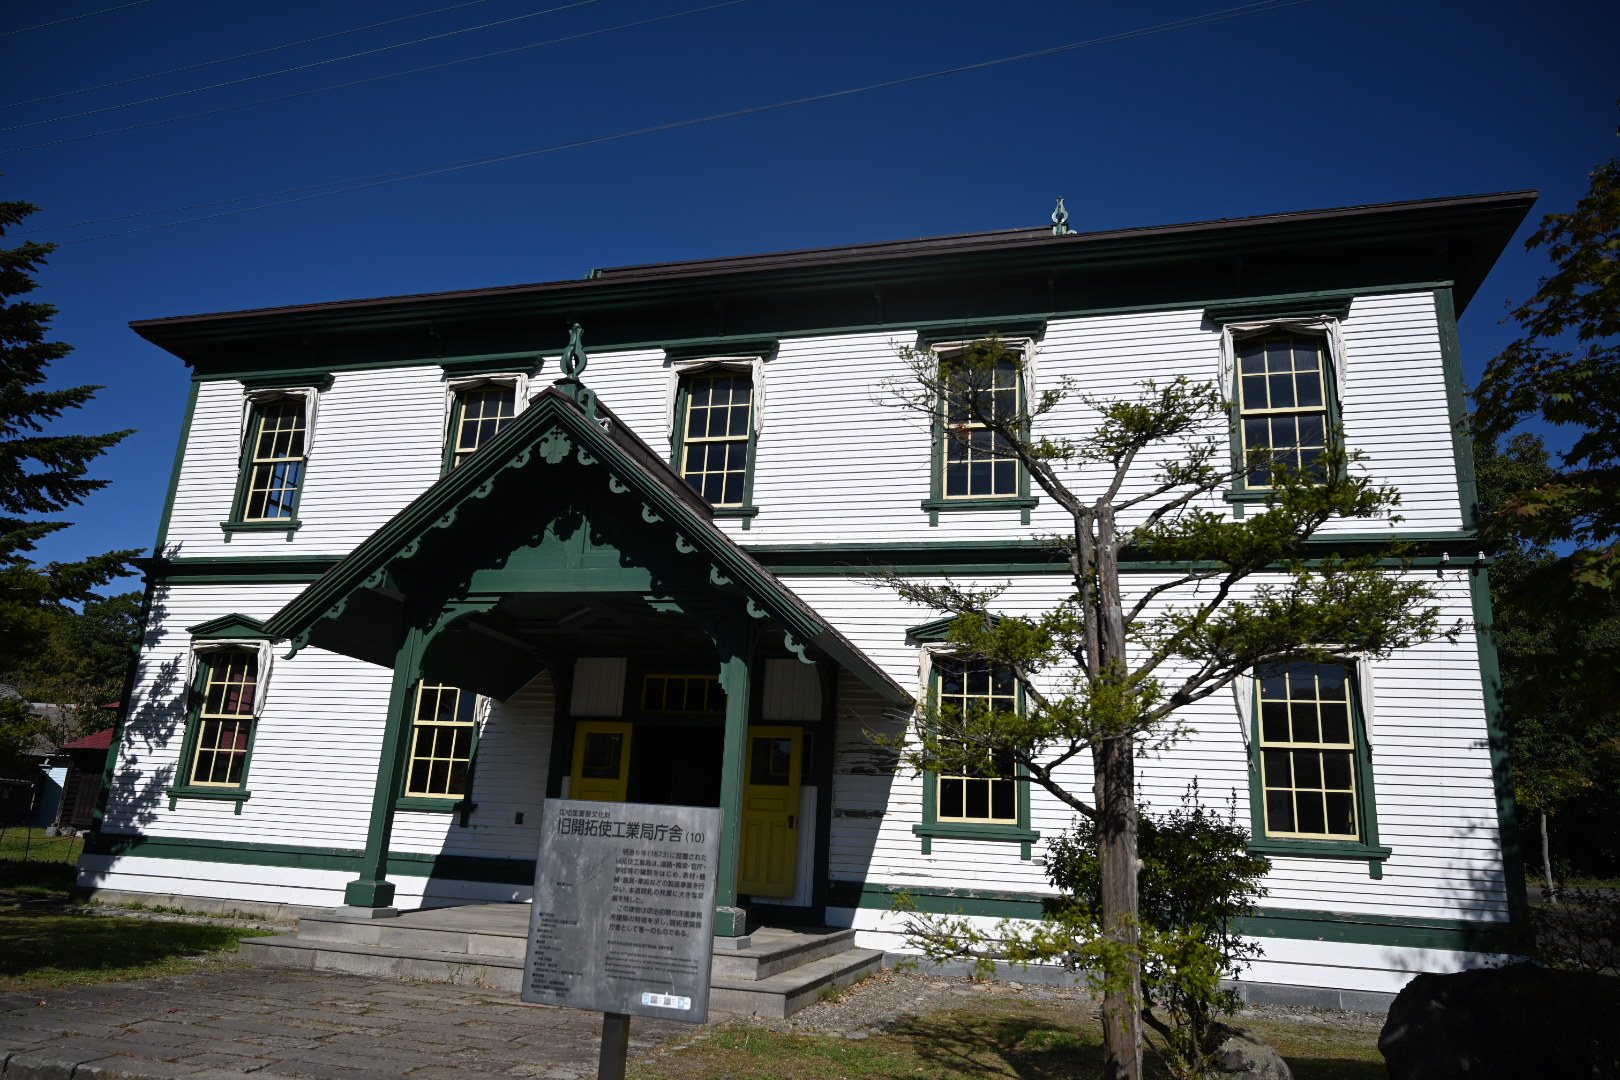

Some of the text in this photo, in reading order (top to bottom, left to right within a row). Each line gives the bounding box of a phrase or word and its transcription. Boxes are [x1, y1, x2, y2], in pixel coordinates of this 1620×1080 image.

[558, 818, 705, 843] 旧開拓使工業局庁舎 (10)
